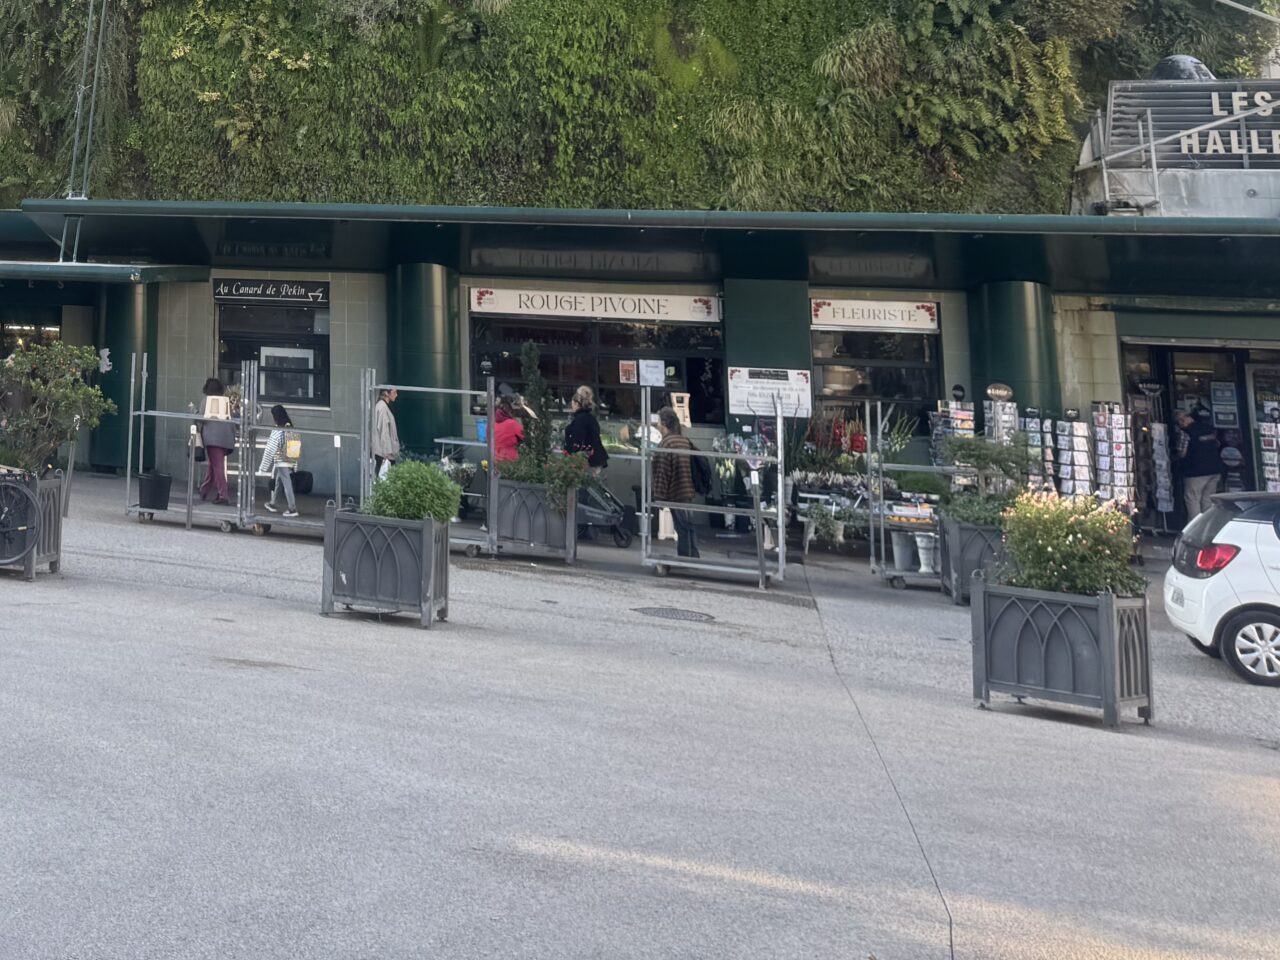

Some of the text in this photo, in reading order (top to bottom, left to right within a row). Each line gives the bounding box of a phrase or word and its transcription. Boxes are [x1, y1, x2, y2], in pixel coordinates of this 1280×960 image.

[1211, 91, 1273, 117] LES
[216, 282, 228, 295] Au
[232, 282, 263, 295] Canard
[266, 284, 276, 295] de
[518, 293, 586, 312] ROUGE
[591, 296, 669, 315] PIVOINE
[832, 307, 917, 322] FLEURISTE
